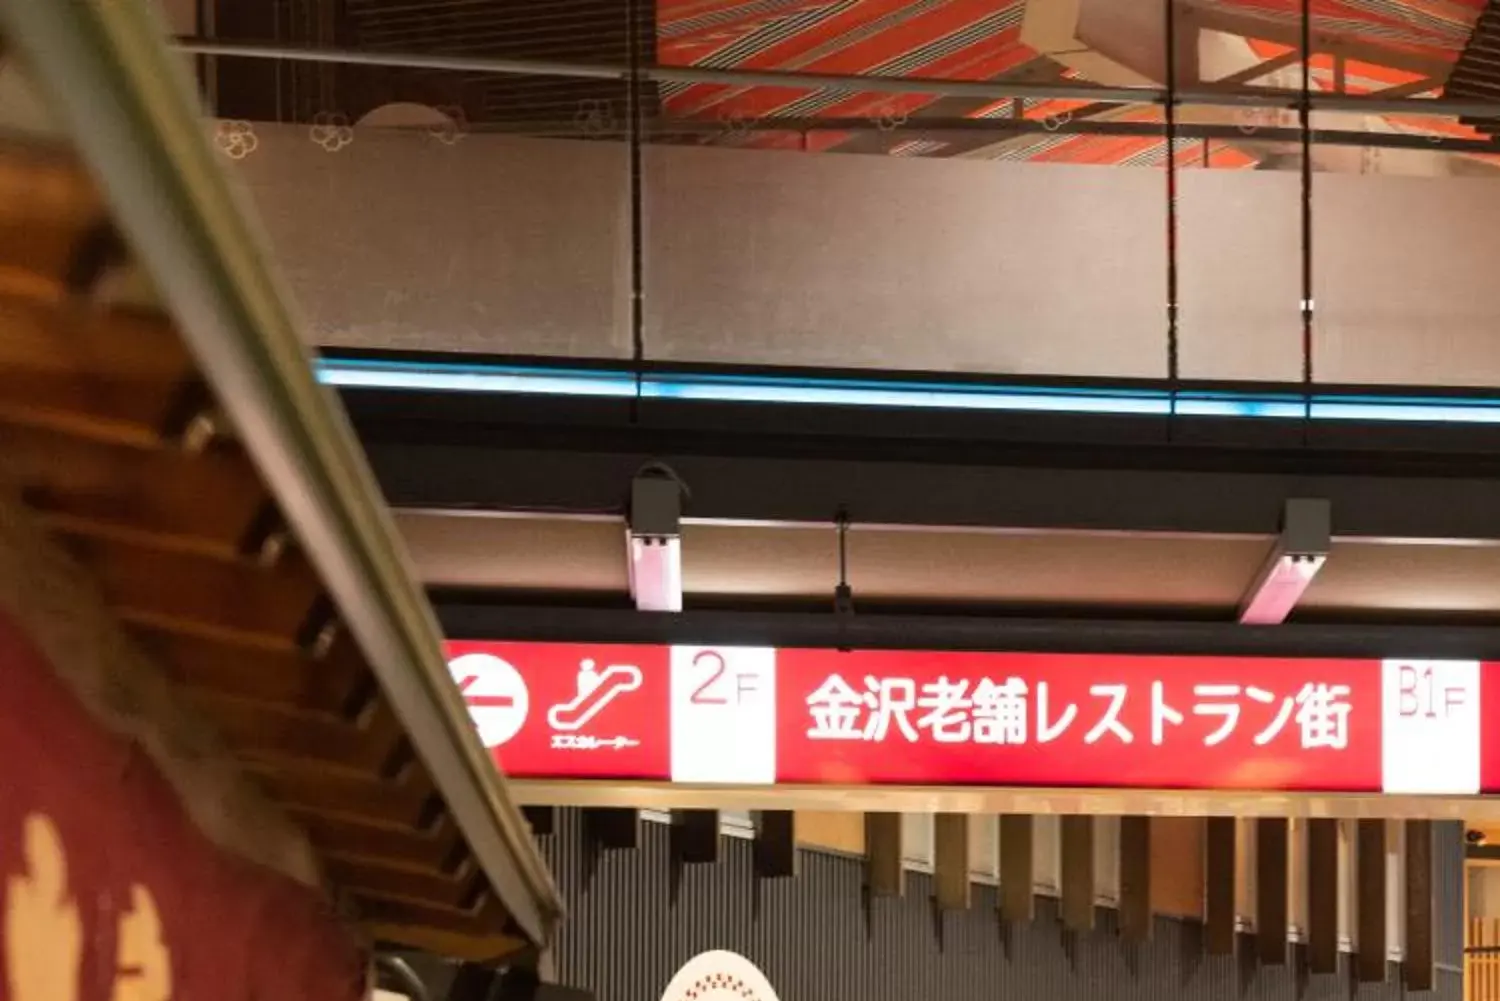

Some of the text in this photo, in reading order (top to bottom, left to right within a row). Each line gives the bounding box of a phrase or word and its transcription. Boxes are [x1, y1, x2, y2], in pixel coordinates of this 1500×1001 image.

[689, 650, 759, 705] 2F
[1398, 665, 1466, 718] B1F
[805, 672, 1353, 749] 金沢老舗レストラン街
